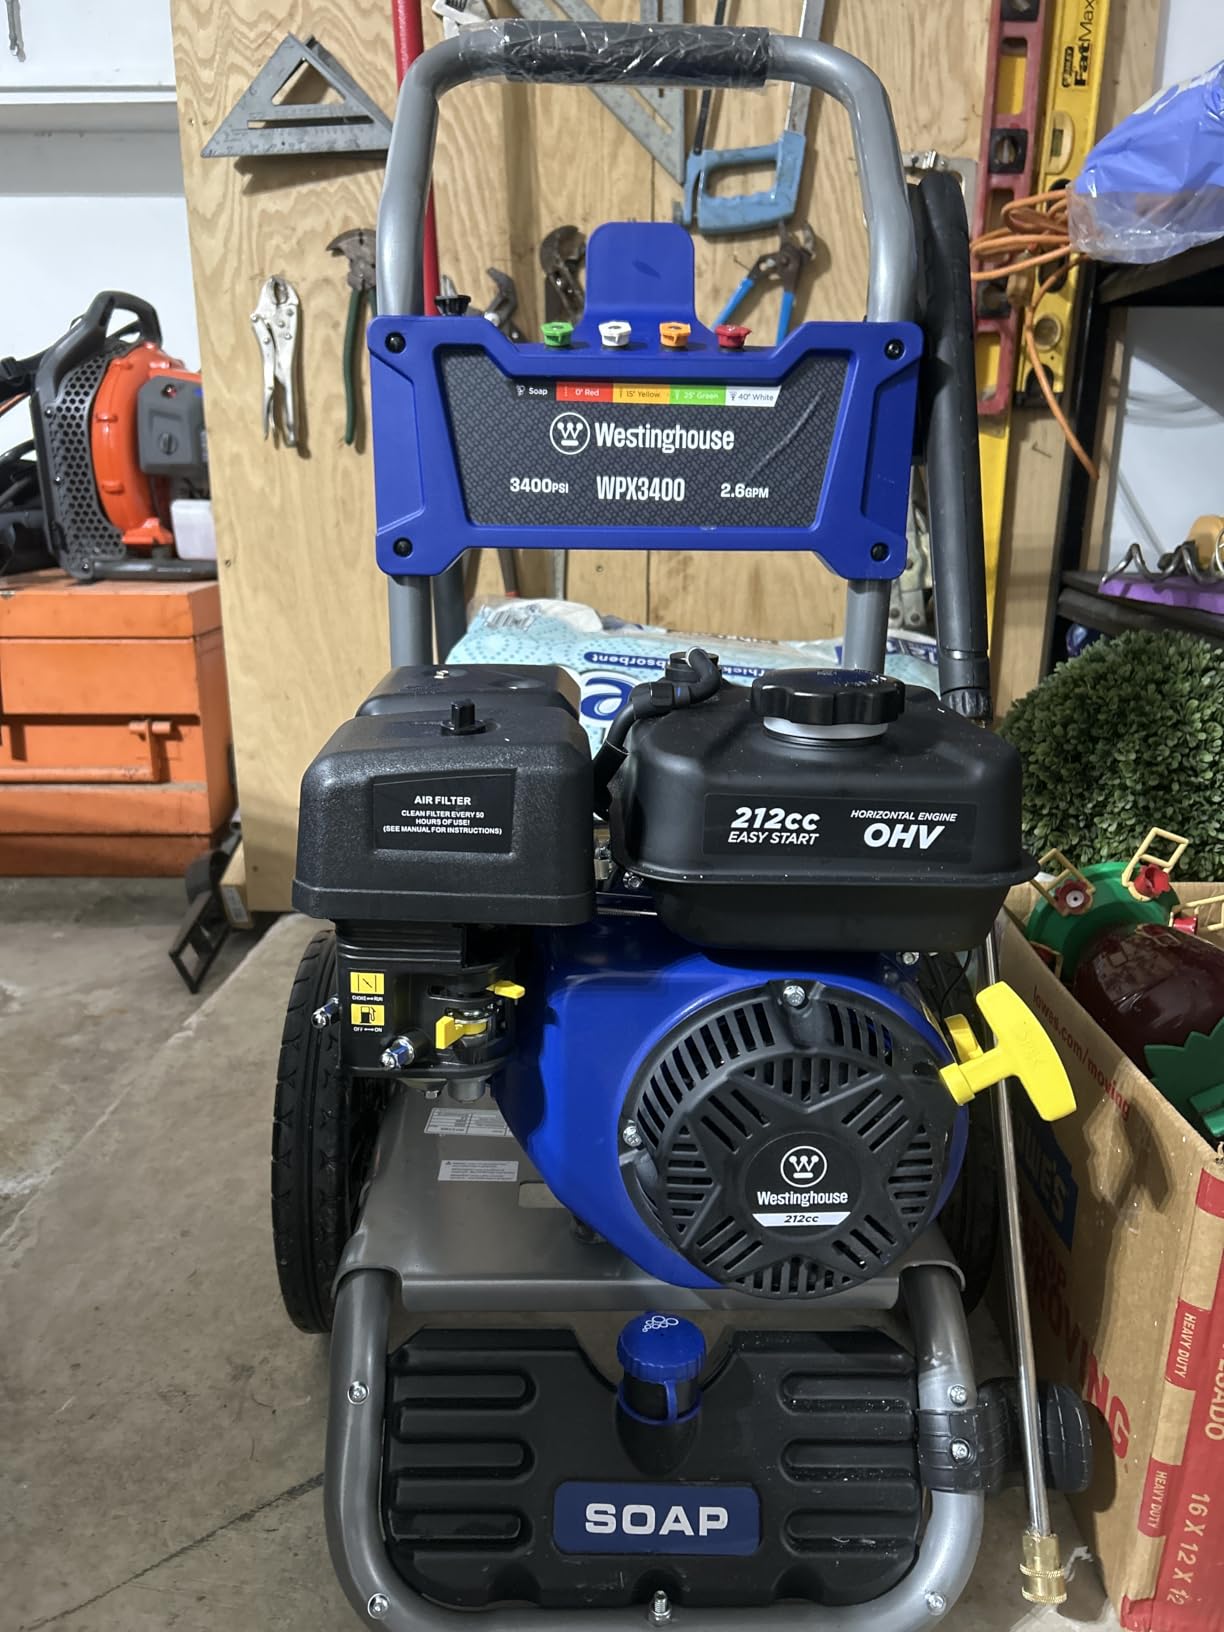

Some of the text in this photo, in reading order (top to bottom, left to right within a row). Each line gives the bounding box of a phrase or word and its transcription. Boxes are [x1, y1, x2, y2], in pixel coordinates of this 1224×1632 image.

[528, 387, 548, 396] Soap
[584, 389, 600, 397] Red
[637, 391, 661, 399] Yellow
[697, 392, 719, 400] Green
[595, 422, 735, 454] Westinghouse
[596, 475, 685, 501] WPX3400
[720, 483, 769, 498] 2.6GPM
[592, 653, 671, 671] bsorbent
[414, 795, 471, 806] AIR FILTER
[475, 811, 485, 819] 50
[730, 806, 821, 831] 212cc
[850, 809, 958, 822] HORIZONTAL ENGINE
[382, 825, 400, 833] (SEE
[400, 825, 430, 833] MANUAL
[447, 827, 503, 835] INSTRUCTIONS)
[728, 831, 820, 845] EASY START
[863, 822, 946, 850] OHV
[1033, 986, 1130, 1121] lowes.com/moving
[757, 1190, 848, 1208] Westinghouse
[784, 1214, 819, 1224] 212cc
[1173, 1312, 1197, 1380] HEAVY DUTY
[1147, 1470, 1168, 1529] HEAVY DUTY
[585, 1503, 729, 1537] SOAP
[1166, 1493, 1211, 1606] 16 X 12 X 12
